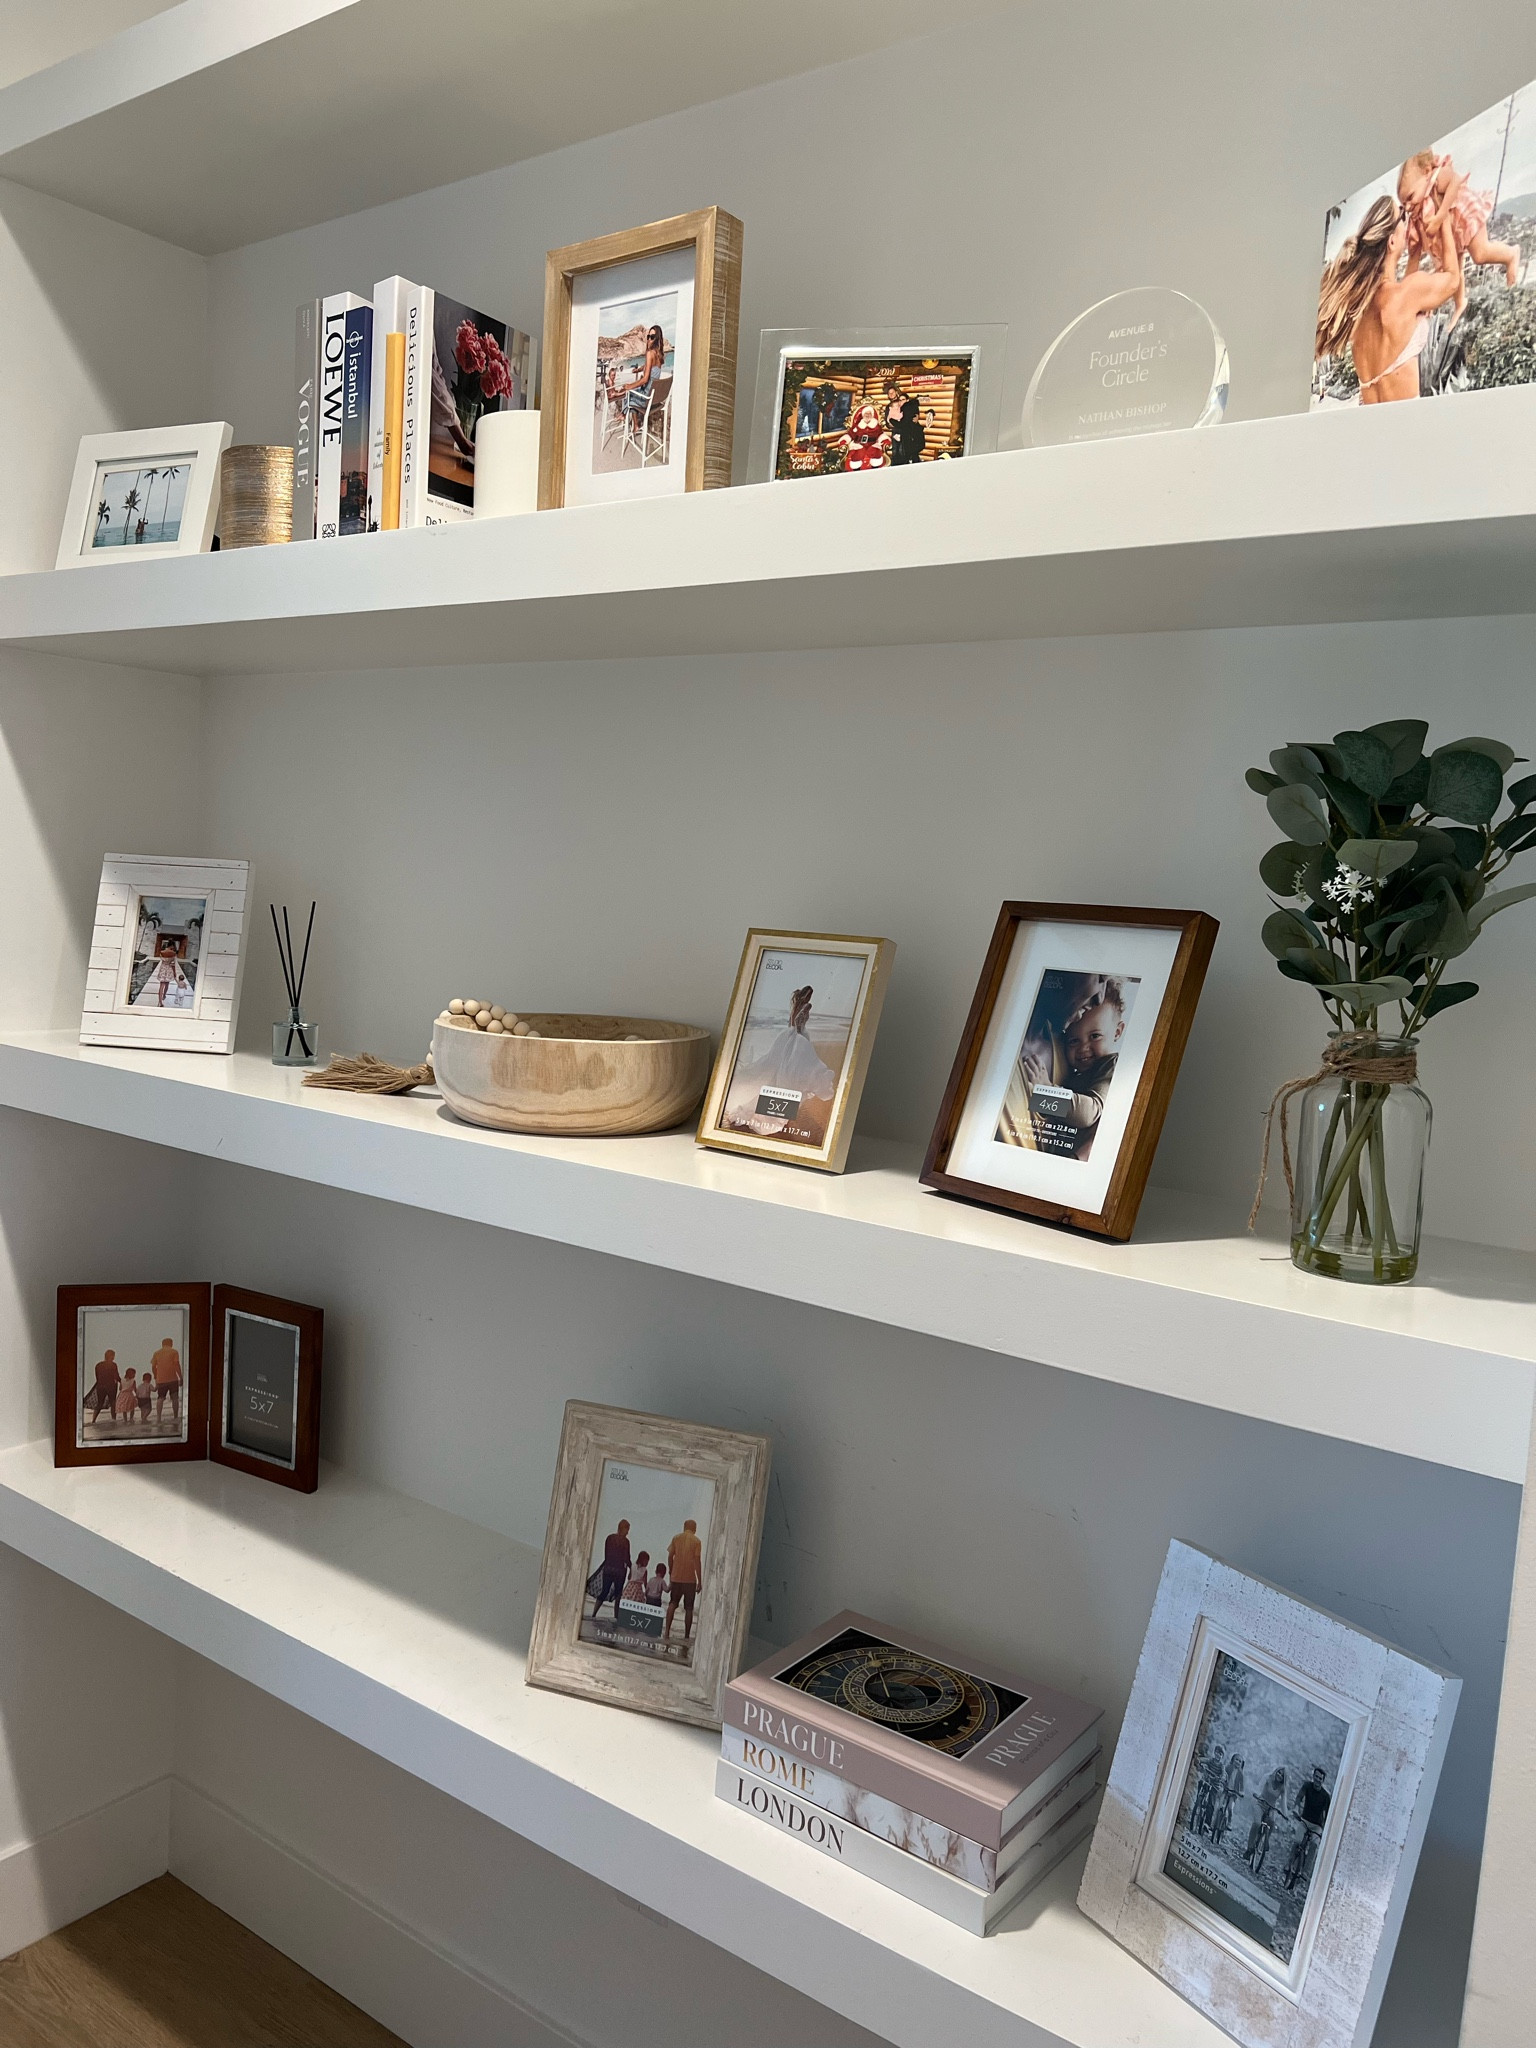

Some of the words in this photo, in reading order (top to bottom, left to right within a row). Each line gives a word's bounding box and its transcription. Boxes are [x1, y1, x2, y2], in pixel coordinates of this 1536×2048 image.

[1108, 324, 1146, 340] AVENUE
[407, 307, 417, 407] Delicious
[1089, 340, 1168, 370] Founder's
[323, 312, 345, 448] LOEWE
[348, 352, 361, 419] istanbul
[1102, 364, 1149, 388] Circle
[1078, 410, 1122, 424] NATHAN
[1125, 402, 1167, 418] BISHOP
[297, 377, 310, 488] VOGUE
[404, 419, 414, 484] Places
[790, 454, 820, 465] Santa's
[762, 1088, 799, 1098] EXPRESSIONS
[768, 1099, 788, 1112] 5x7
[1040, 1099, 1058, 1112] 4x6
[788, 1127, 800, 1135] 17.7
[801, 1130, 811, 1138] cm)
[250, 1396, 274, 1414] 5x7
[622, 1602, 661, 1614] EXPRESSIONS
[630, 1614, 652, 1629] 5x7
[668, 1647, 679, 1655] cm)
[744, 1701, 844, 1769] PRAGUE
[985, 1712, 1056, 1766] PRAGUE
[742, 1738, 814, 1796] ROME
[738, 1776, 844, 1854] LONDON
[1197, 1845, 1201, 1853] 7
[1201, 1850, 1208, 1860] in
[1178, 1848, 1190, 1860] 12.7
[1190, 1858, 1199, 1868] cm
[1206, 1867, 1219, 1880] 17.7
[1218, 1879, 1228, 1889] cm
